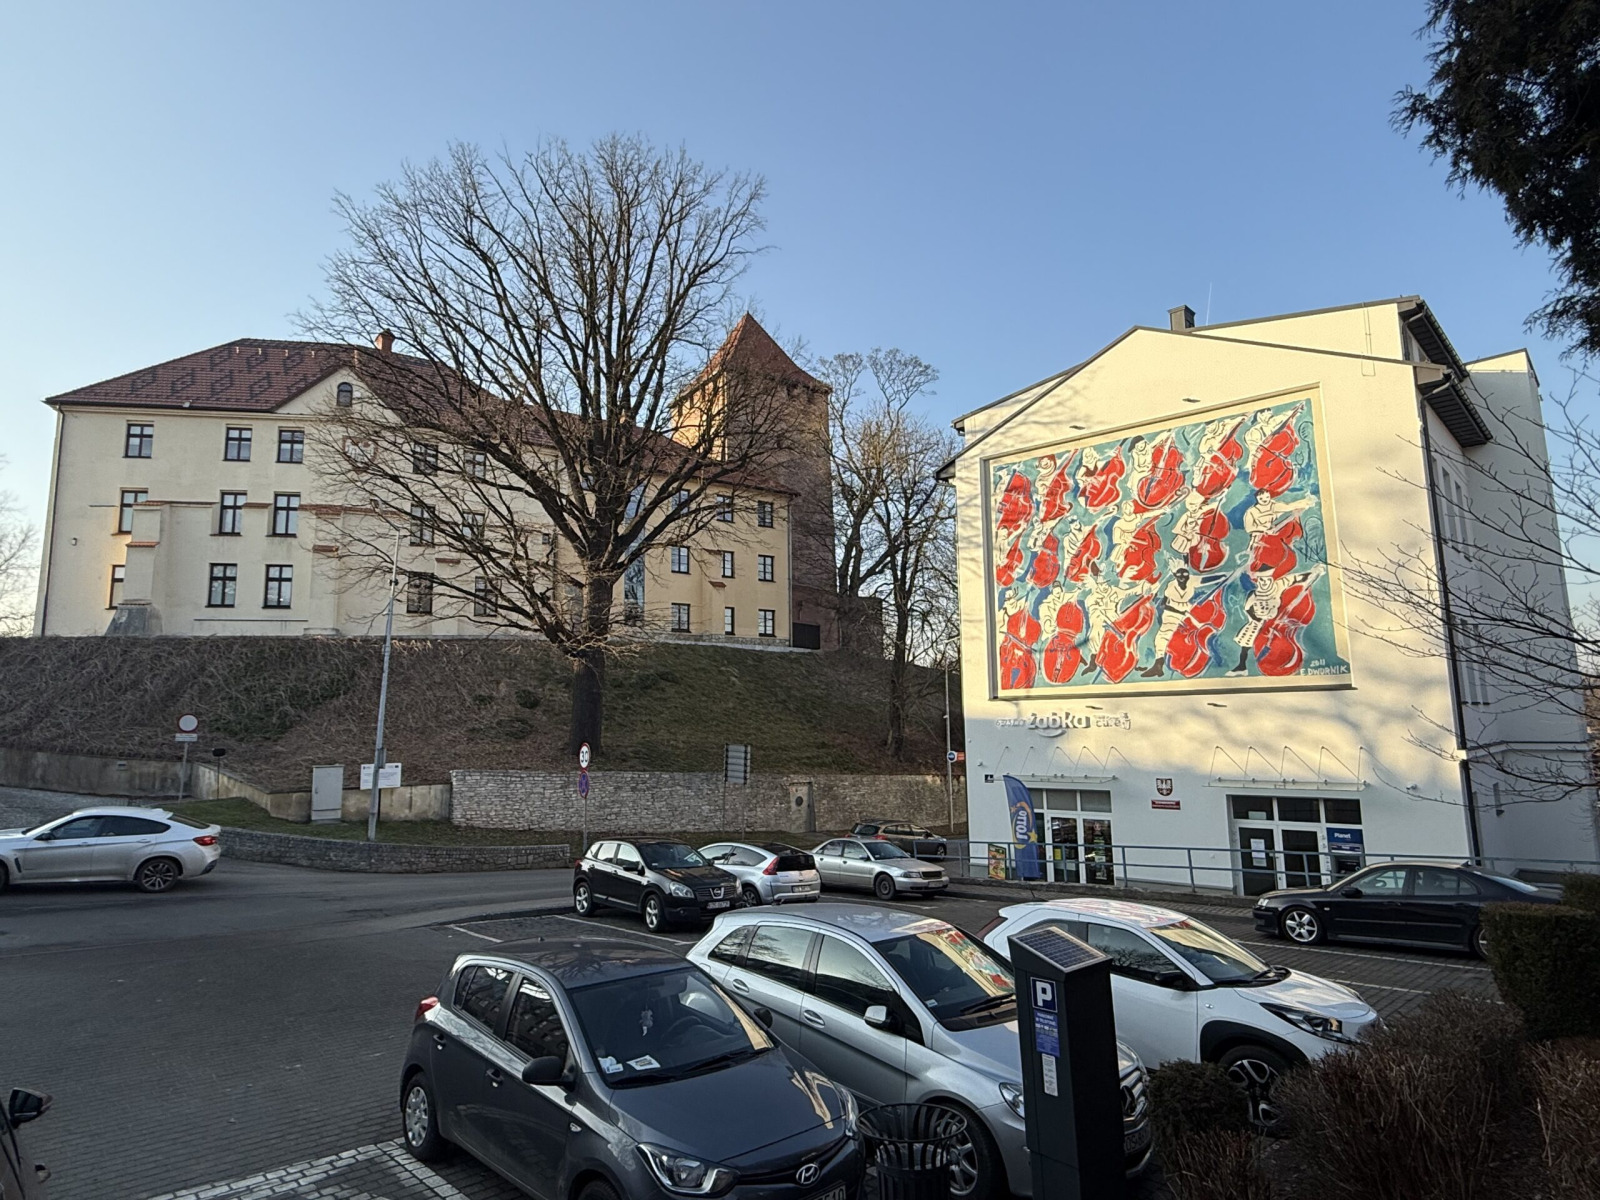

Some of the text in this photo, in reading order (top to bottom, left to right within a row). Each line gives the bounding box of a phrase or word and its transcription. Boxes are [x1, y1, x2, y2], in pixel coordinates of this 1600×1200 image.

[580, 750, 589, 763] 30
[1016, 810, 1029, 840] LOTTO
[1035, 980, 1053, 1007] P
